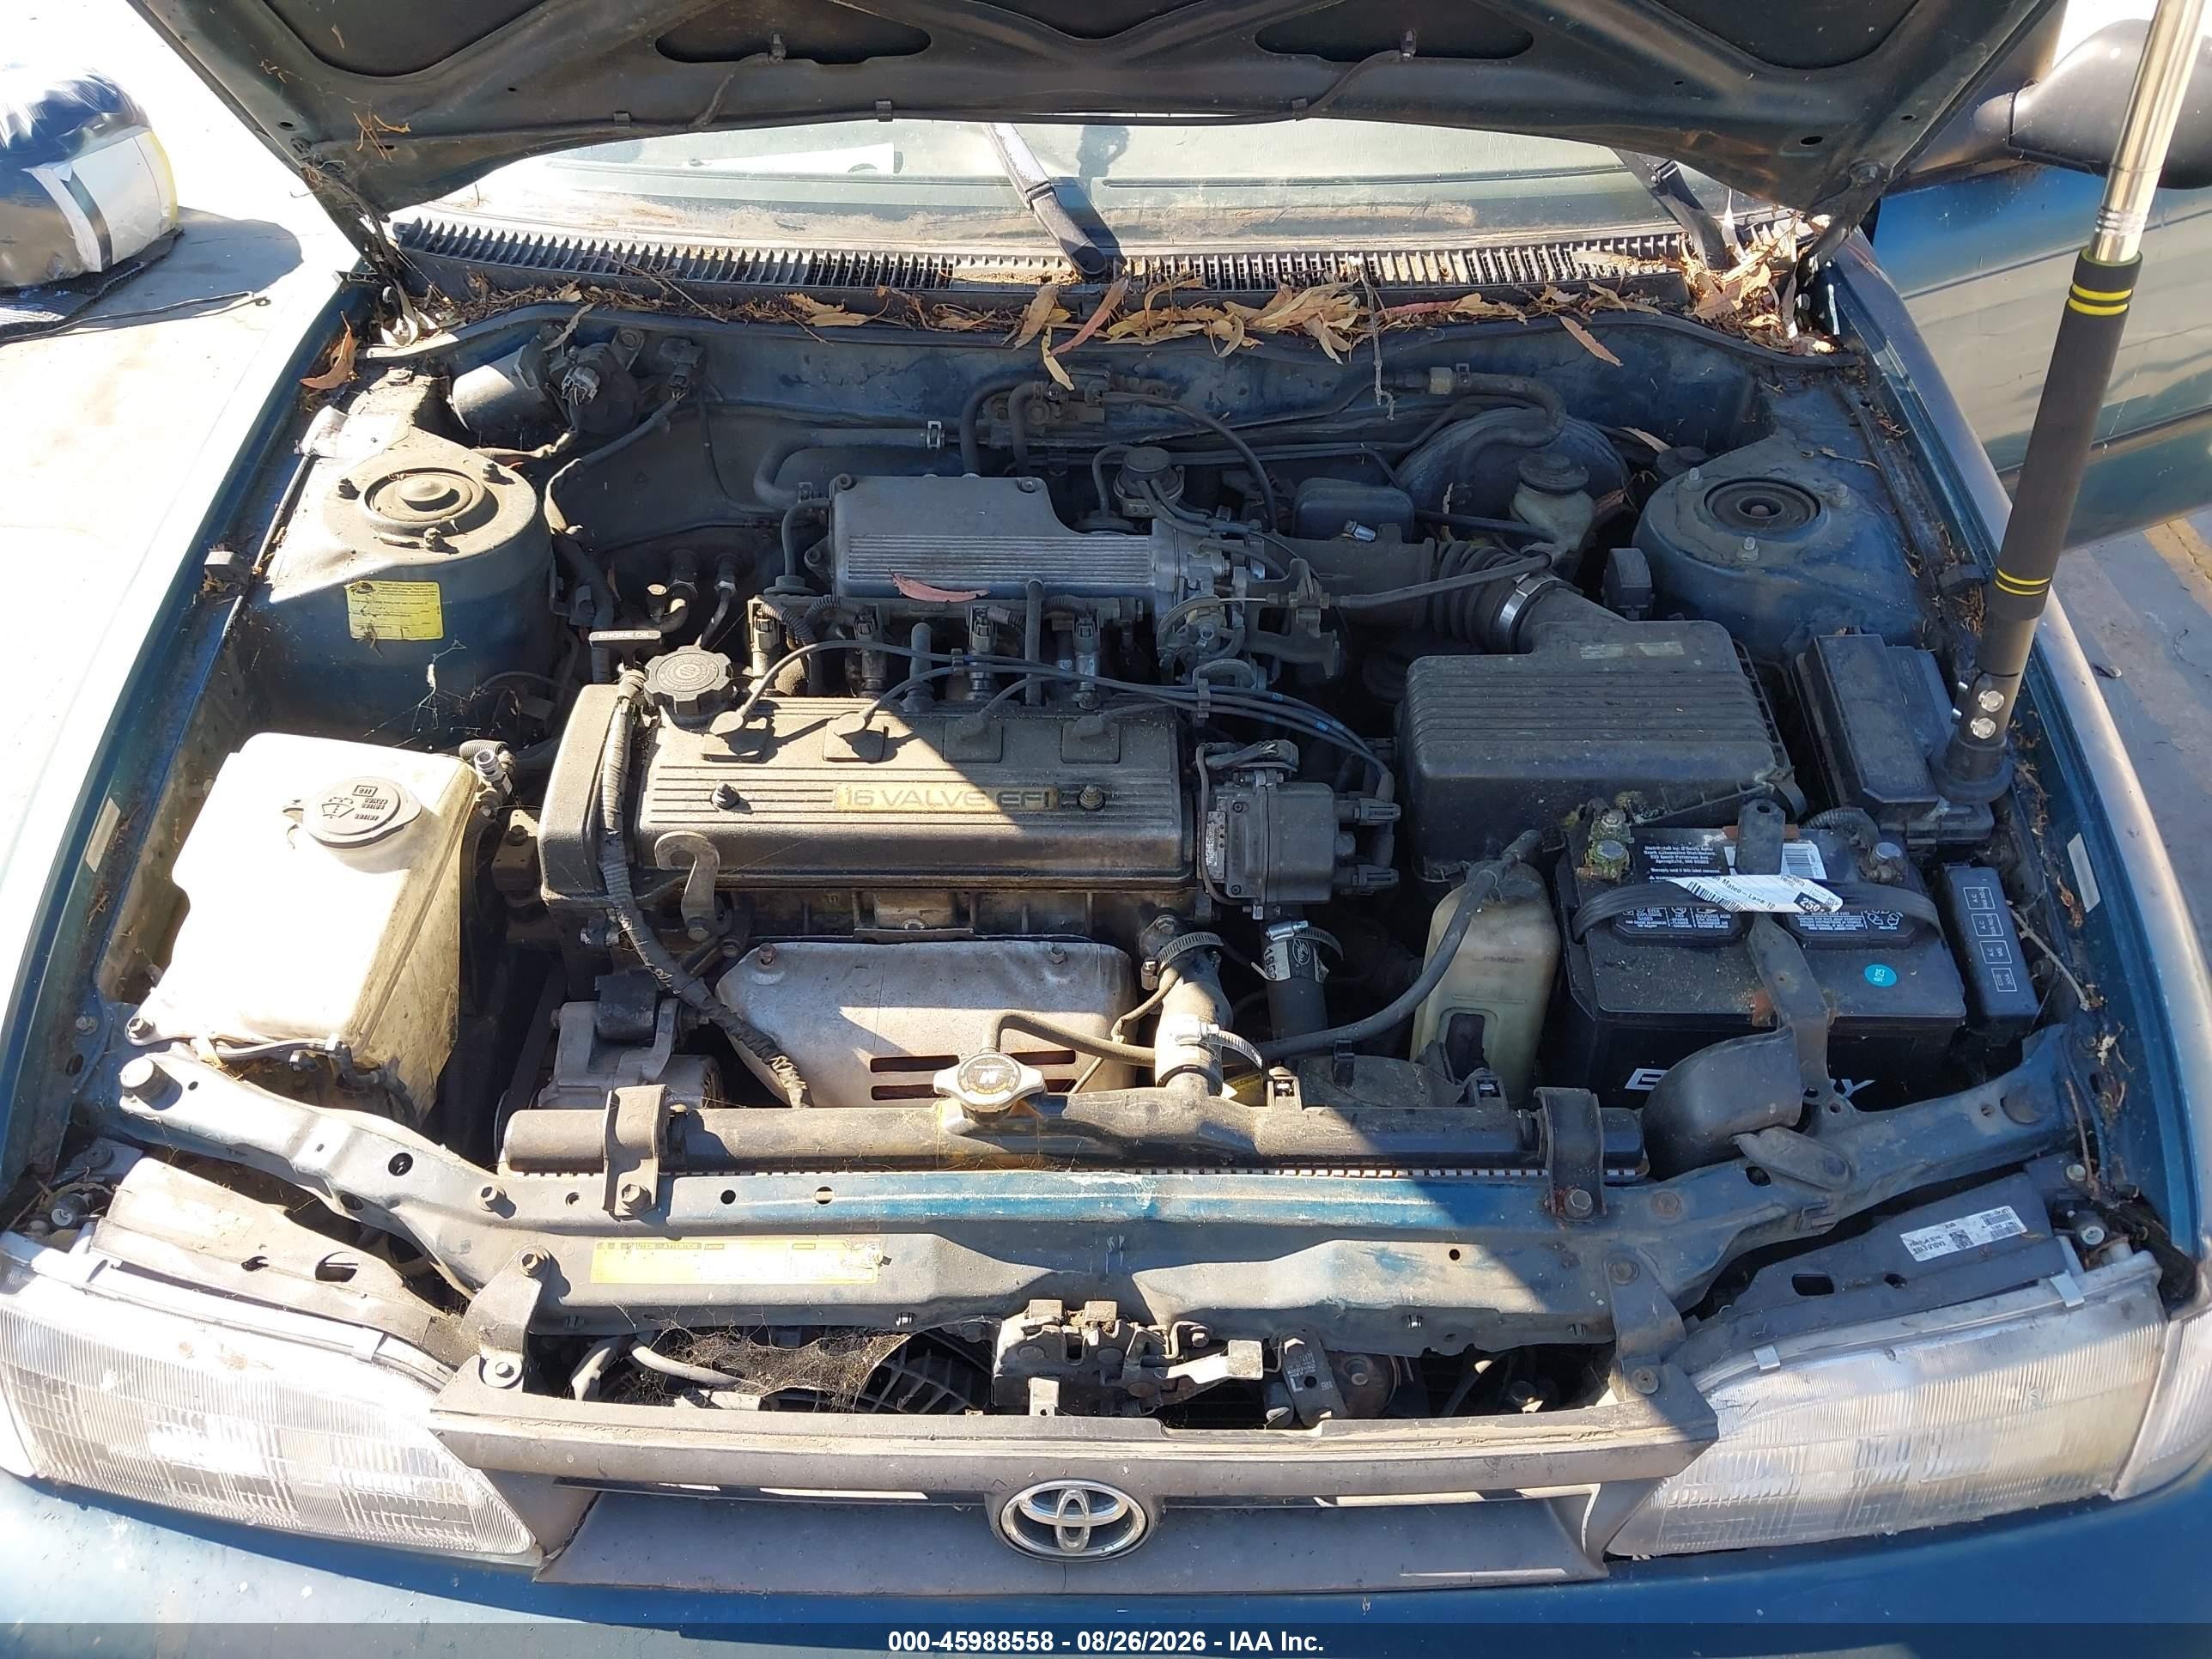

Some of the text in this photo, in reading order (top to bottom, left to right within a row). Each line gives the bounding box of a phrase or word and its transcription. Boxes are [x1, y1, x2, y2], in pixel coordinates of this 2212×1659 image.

[846, 788, 1050, 810] 16 VALVE EFI
[1722, 878, 1741, 894] Mateo
